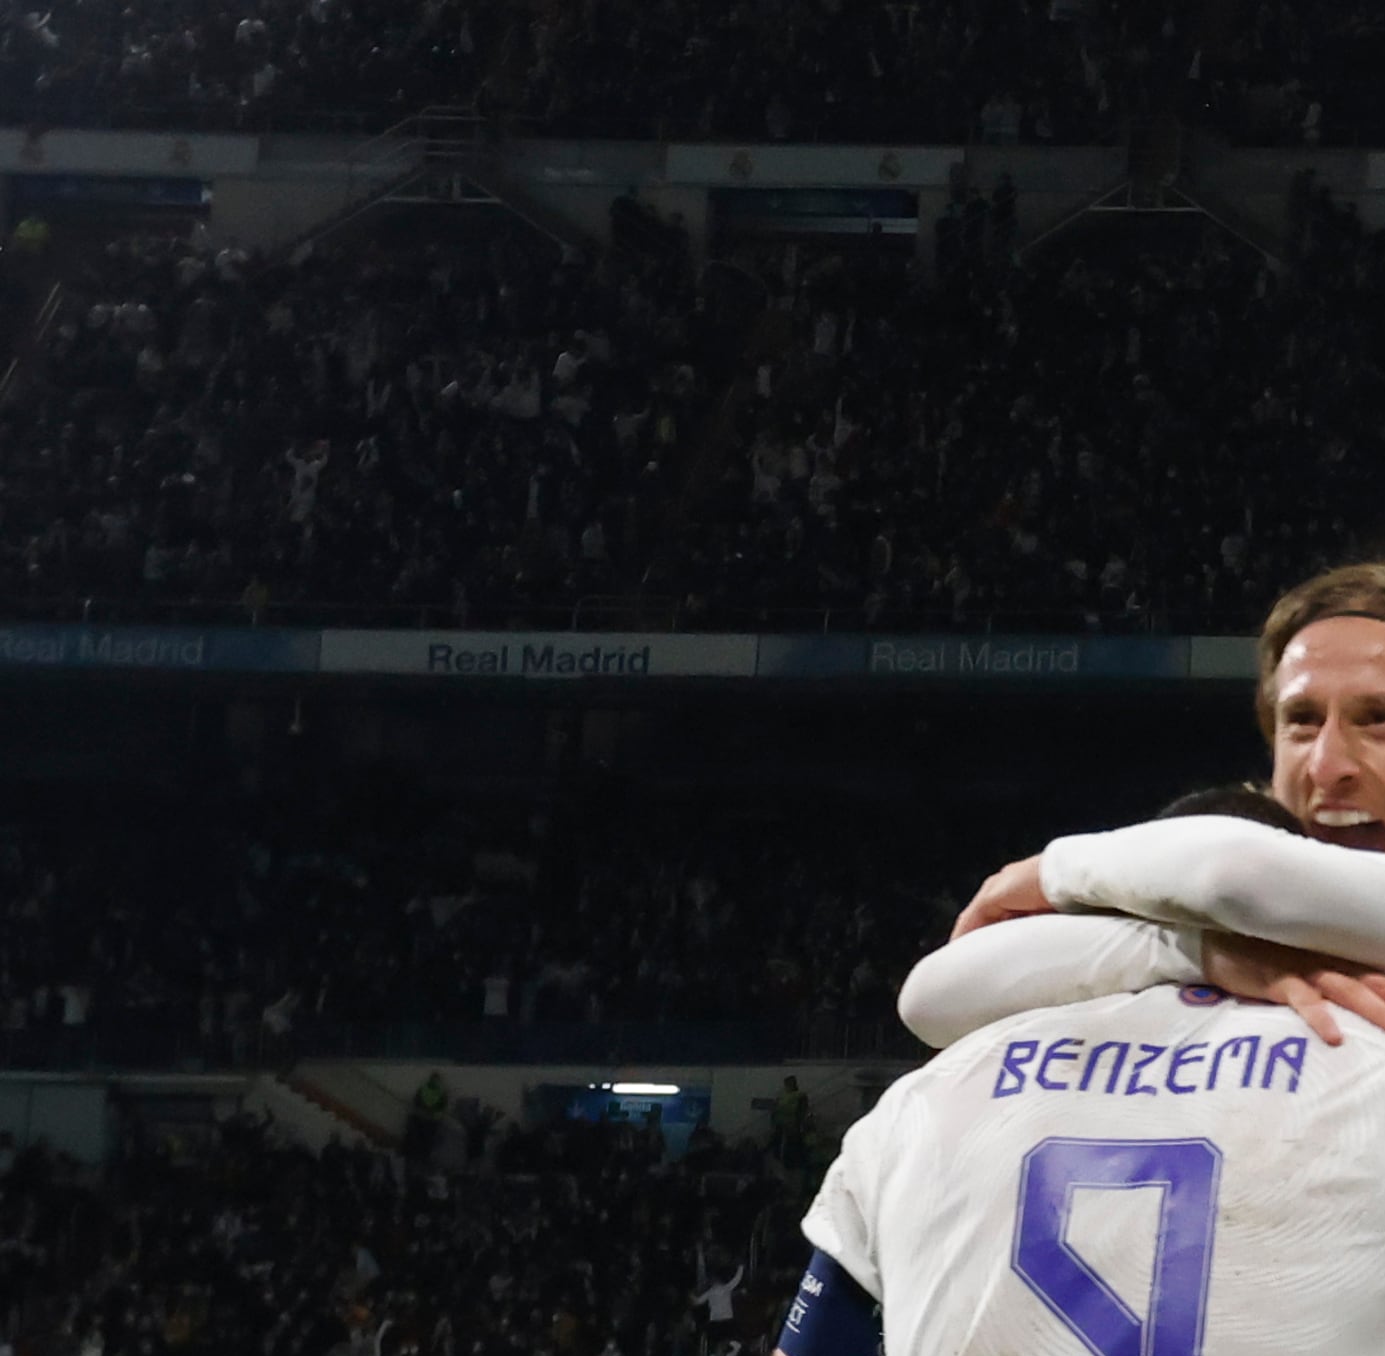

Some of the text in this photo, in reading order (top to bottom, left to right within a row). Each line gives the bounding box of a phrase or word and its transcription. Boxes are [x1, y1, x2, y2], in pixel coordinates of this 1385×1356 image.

[428, 644, 650, 675] Real Madrid
[871, 642, 1080, 673] Real Madrid
[993, 1035, 1308, 1099] BENZEMA
